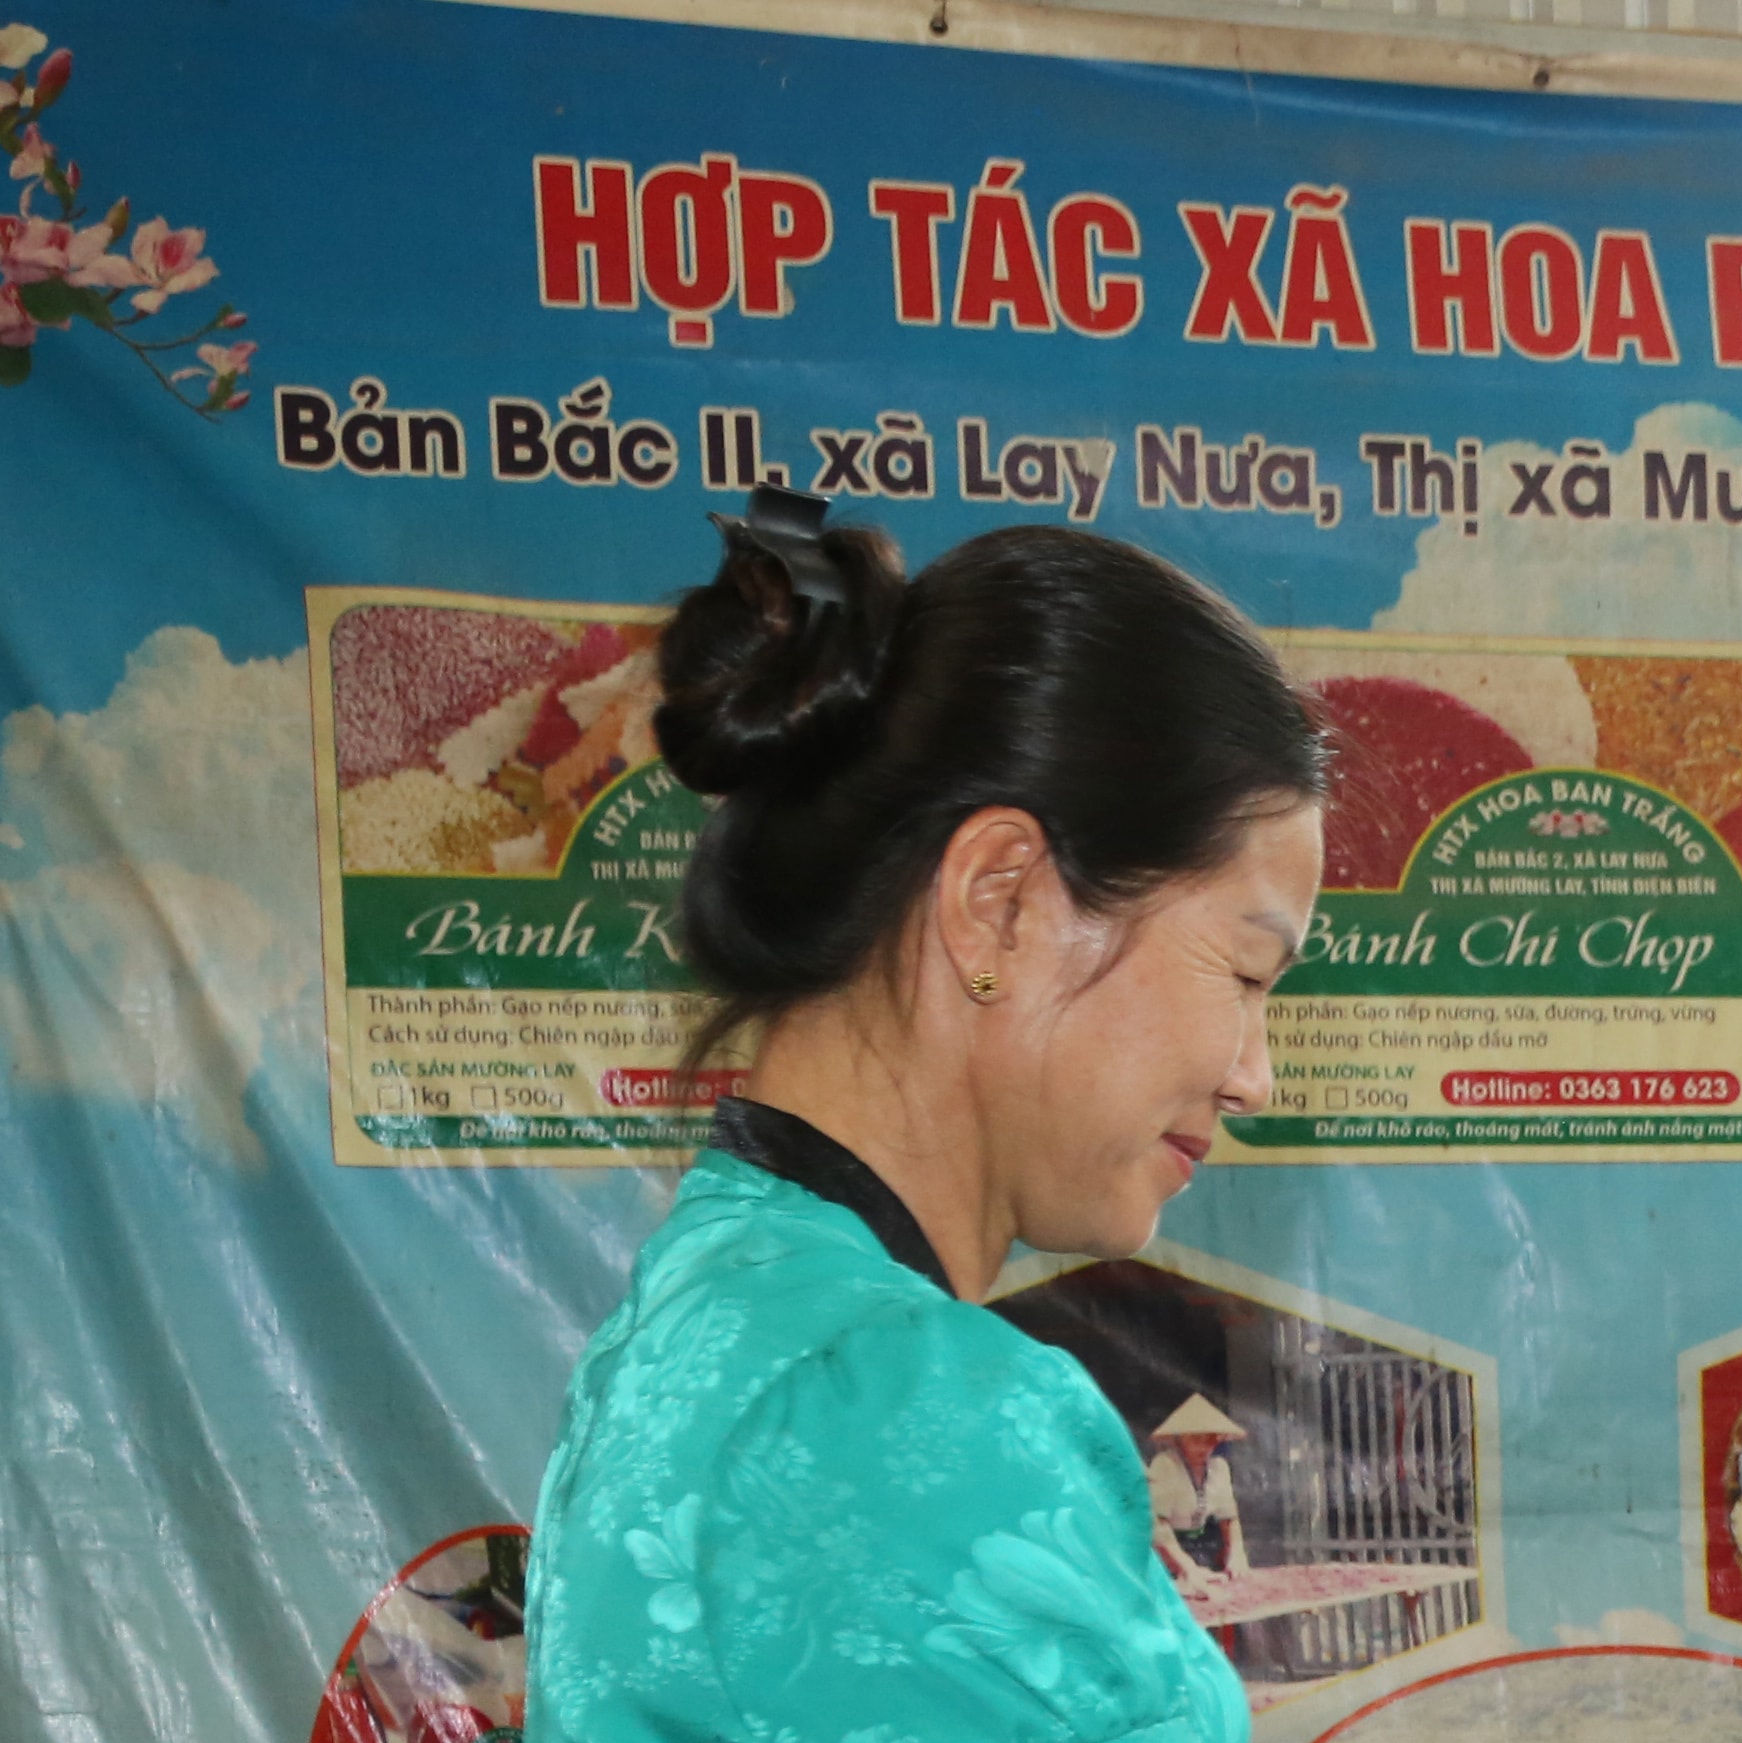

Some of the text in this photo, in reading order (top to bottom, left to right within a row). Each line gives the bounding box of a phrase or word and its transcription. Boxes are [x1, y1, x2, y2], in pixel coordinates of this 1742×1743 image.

[535, 153, 832, 346] HỢP
[870, 157, 1143, 334] TÁC
[1180, 184, 1375, 350] XÃ
[1405, 217, 1677, 367] HOA
[276, 375, 466, 481] Bản
[490, 377, 677, 486] Bắc
[810, 410, 934, 499] xã
[960, 420, 1111, 520] Lay
[1136, 425, 1342, 527] Nưa,
[1361, 433, 1480, 537] Thị
[1507, 441, 1610, 520] xã
[593, 788, 647, 847] HTX
[1432, 778, 1706, 866] HTX HOA BAN TRẮNG
[405, 899, 595, 958] Bánh
[1298, 908, 1437, 967] Bánh
[1578, 908, 1715, 993] Chọp
[1355, 1088, 1408, 1111] 500g
[1385, 1065, 1416, 1080] LAY
[1452, 1077, 1728, 1101] Hotline: 0363 176 623
